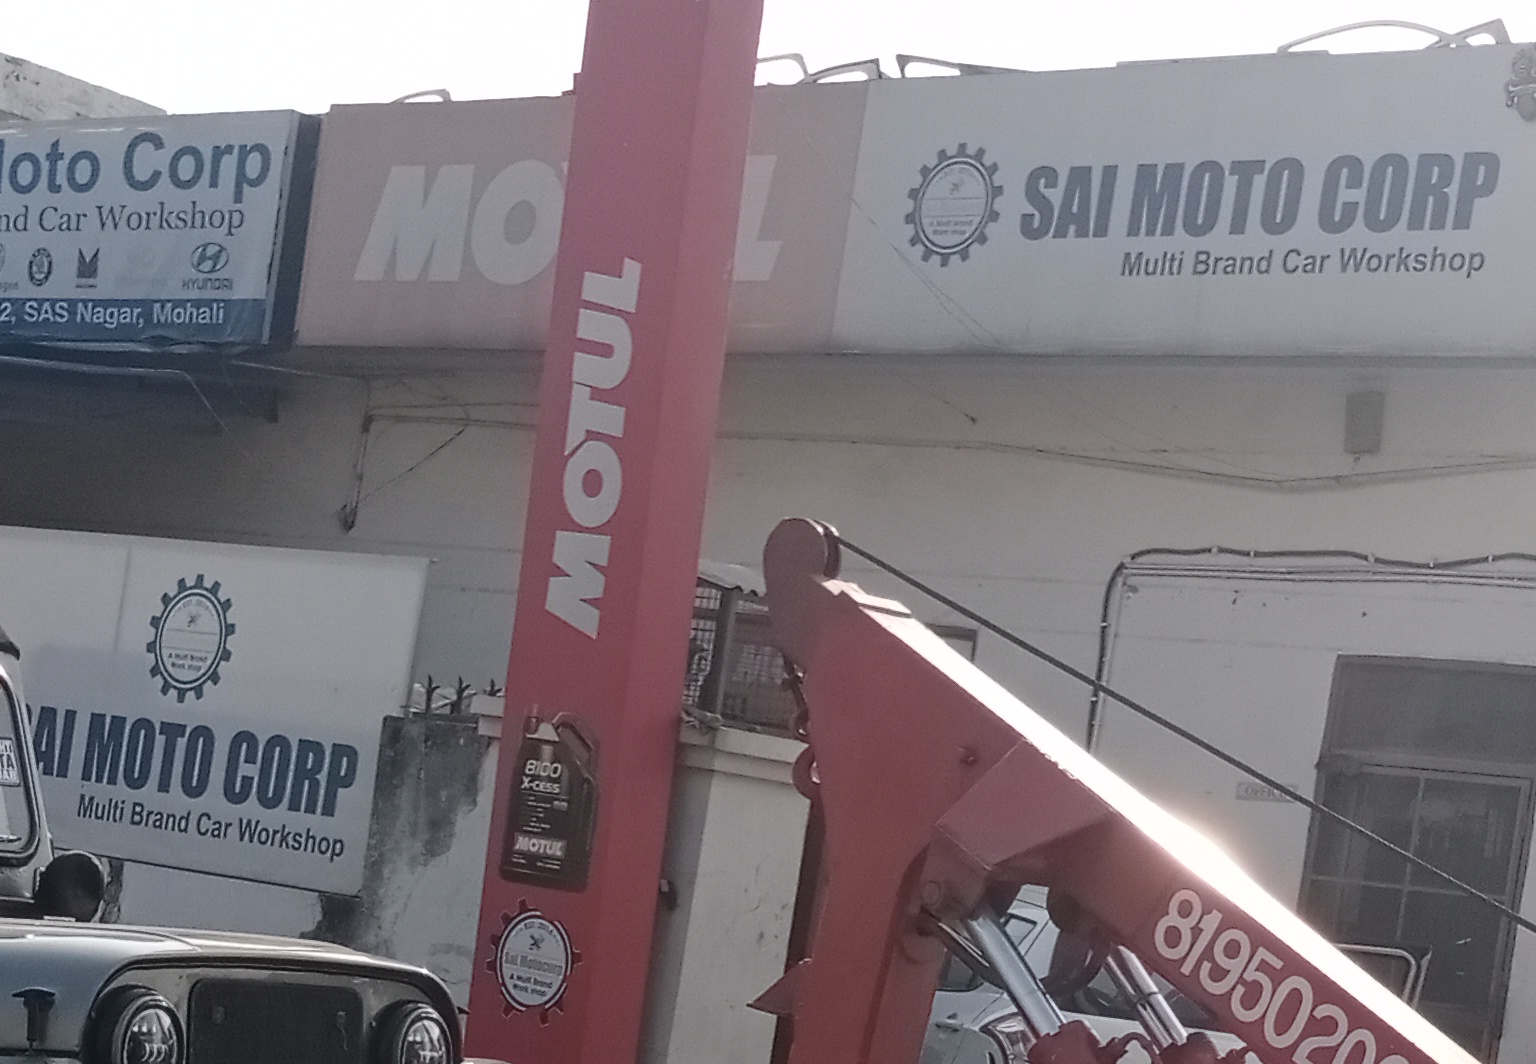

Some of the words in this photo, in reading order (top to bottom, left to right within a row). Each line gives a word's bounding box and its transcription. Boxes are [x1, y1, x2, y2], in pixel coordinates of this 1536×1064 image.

[123, 131, 273, 204] Corp
[38, 207, 90, 233] Car
[95, 201, 245, 237] Workshop
[1019, 163, 1119, 241] SAI
[1126, 156, 1306, 239] MOTO
[1317, 152, 1501, 235] CORP
[1120, 246, 1184, 278] Multi
[1192, 246, 1275, 277] Brand
[1281, 246, 1331, 276] Car
[1339, 245, 1486, 280] Workshop
[23, 302, 69, 323] SAS
[77, 302, 144, 329] Nagar,
[153, 300, 225, 326] Mohali
[544, 257, 643, 640] MOTUL
[26, 703, 77, 779] AI
[82, 711, 216, 799] MOTO
[223, 730, 359, 817] CORP
[525, 759, 562, 778] 8100
[77, 793, 125, 824] Multi
[130, 801, 189, 835] Brand
[196, 812, 232, 842] Car
[238, 816, 345, 863] Workshop
[514, 836, 564, 857] MOTUL
